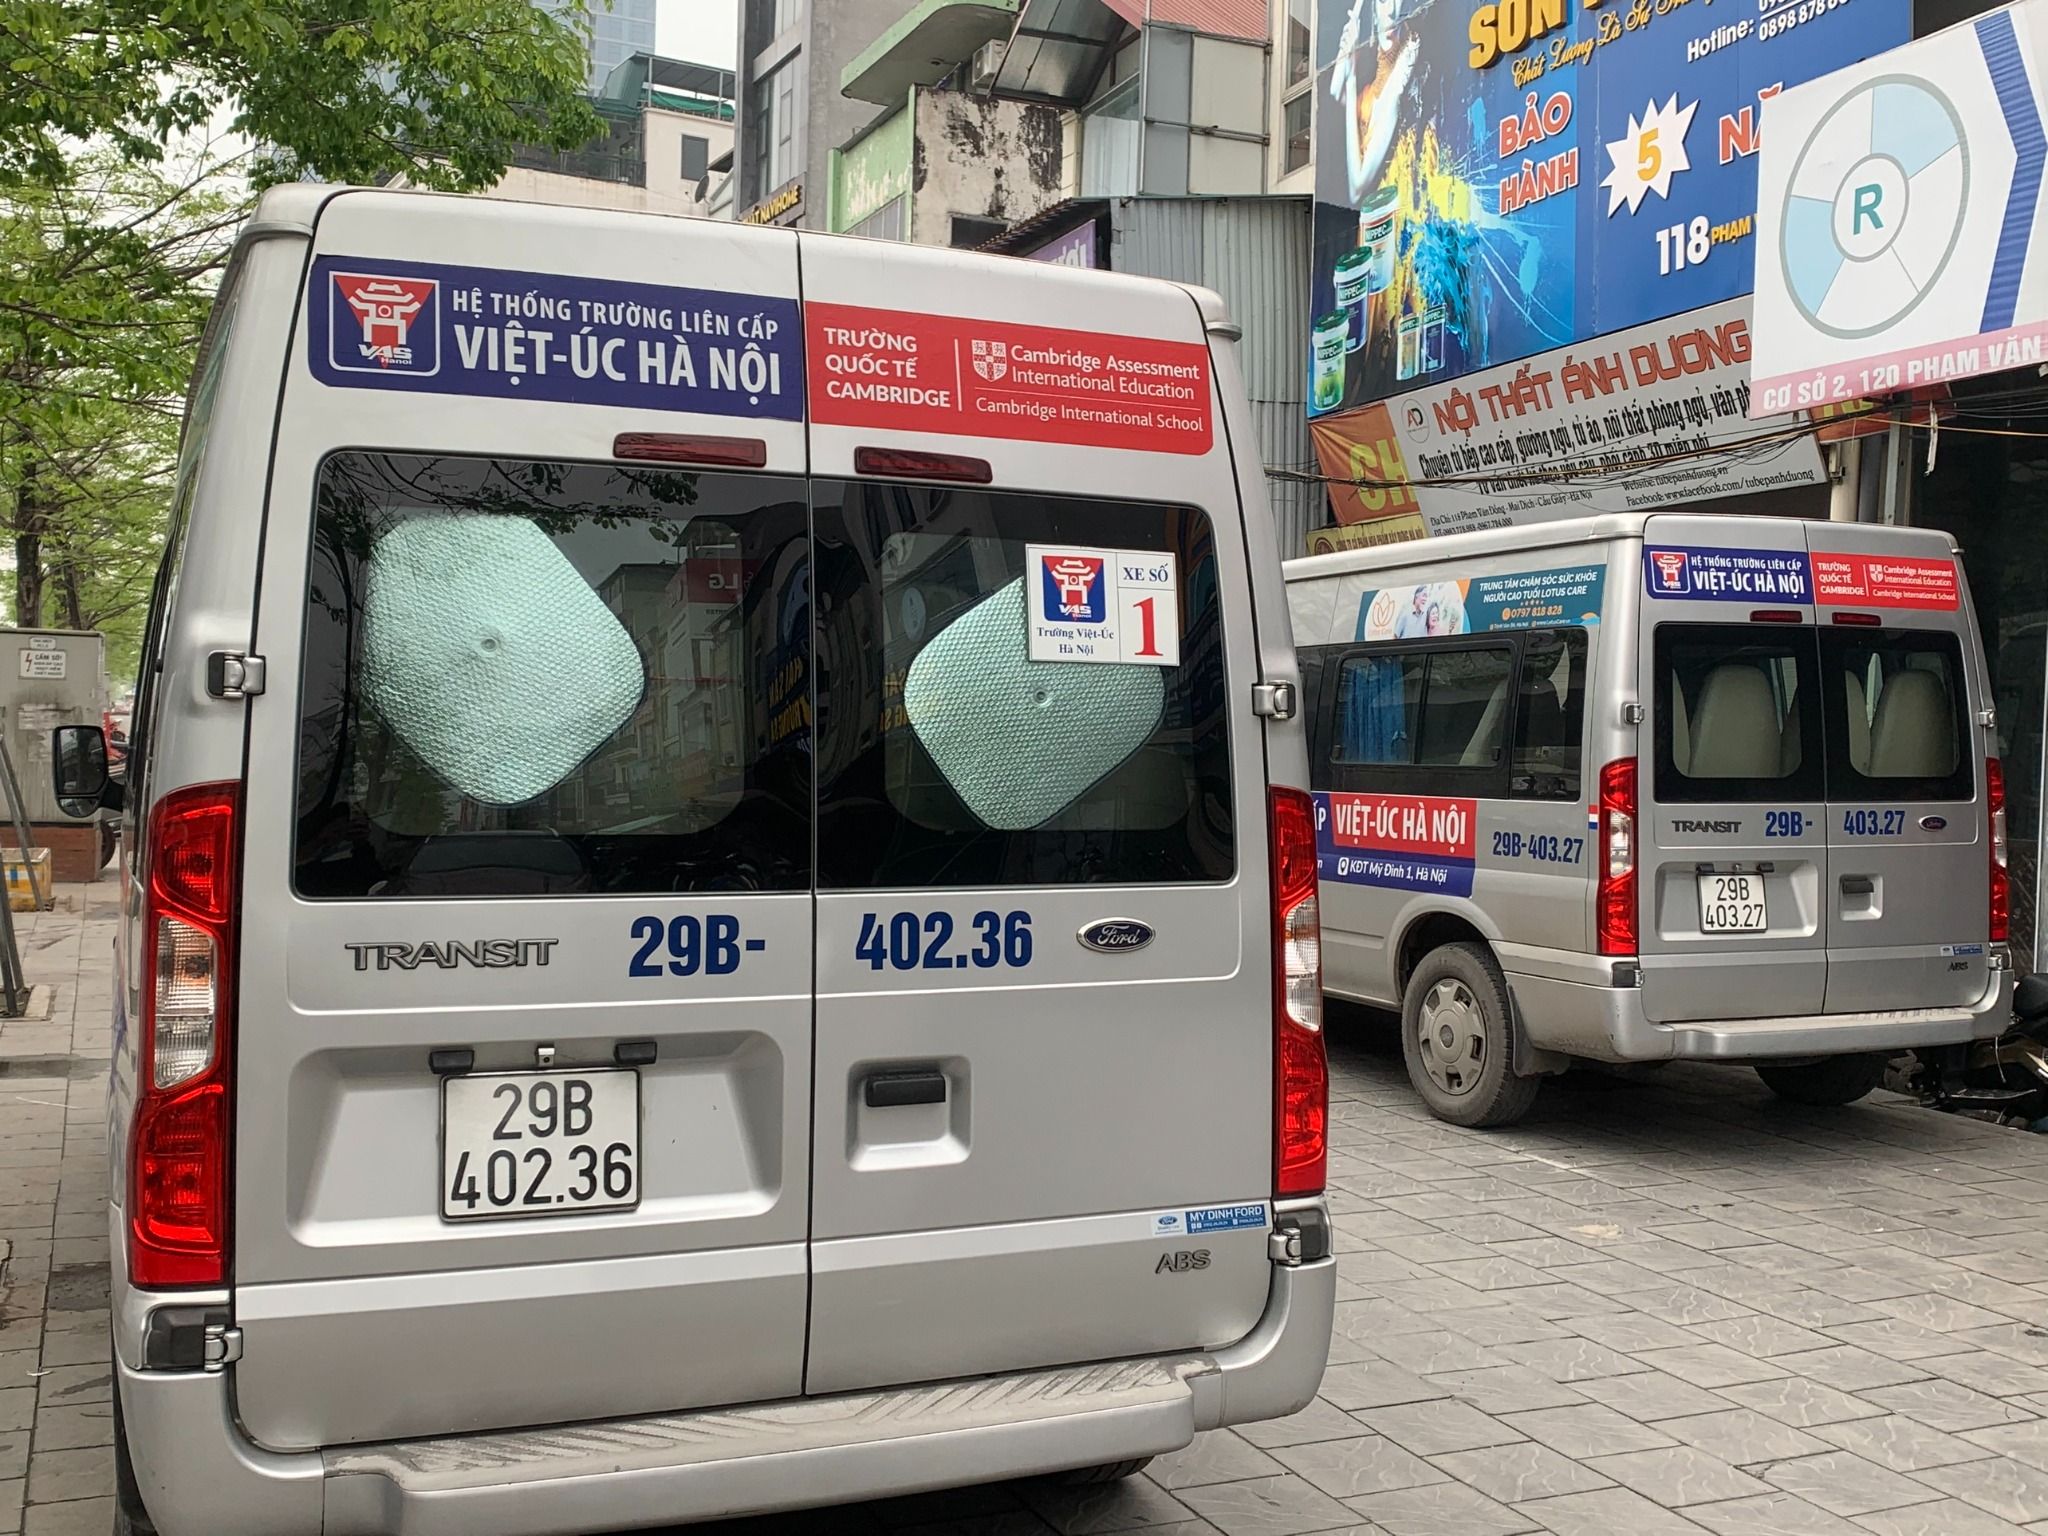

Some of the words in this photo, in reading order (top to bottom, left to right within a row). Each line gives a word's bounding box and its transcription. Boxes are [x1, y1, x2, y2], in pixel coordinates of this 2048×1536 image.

[1687, 19, 1754, 63] Hotline:
[1759, 10, 1797, 41] 0898
[1500, 91, 1573, 158] BẢO
[1637, 127, 1662, 181] 5
[1500, 147, 1579, 216] HÀNH
[1853, 183, 1884, 235] R
[1656, 216, 1710, 275] 118
[1711, 217, 1752, 245] PHẠM
[453, 287, 482, 314] HỆ
[490, 290, 571, 321] THỐNG
[578, 297, 673, 330] TRƯỜNG
[680, 306, 731, 336] LIÊN
[736, 312, 779, 340] CẤP
[358, 344, 412, 360] VAS
[824, 325, 917, 353] TRƯỜNG
[381, 357, 412, 365] Hanoi
[453, 318, 626, 386] VIỆT-ÚC
[638, 335, 697, 388] HÀ
[710, 341, 781, 405] NỘI
[825, 352, 890, 378] QUỐC
[892, 355, 918, 379] TẾ
[1011, 344, 1102, 371] Cambridge
[1106, 354, 1201, 380] Assessment
[1764, 383, 1792, 411] CƠ
[1798, 372, 1827, 402] SỞ
[1832, 375, 1853, 397] 2,
[1860, 364, 1900, 393] 120
[1987, 334, 2041, 369] VĂN
[1012, 366, 1115, 393] International
[1119, 376, 1195, 401] Education
[1432, 386, 1480, 438] NỘI
[1478, 363, 1554, 420] THẤT
[1561, 355, 1629, 404] ÁNH
[1629, 319, 1752, 387] DƯƠNG
[826, 380, 951, 408] CAMBRIDGE
[975, 397, 1057, 423] Cambridge
[1061, 405, 1154, 427] International
[1157, 414, 1204, 432] School
[1418, 449, 1454, 480] Chuyên
[1460, 437, 1480, 472] bếp
[1478, 442, 1498, 467] cao
[1602, 408, 1624, 445] nội
[1622, 398, 1649, 436] thất
[1646, 398, 1686, 437] phòng
[1710, 384, 1739, 417] văn
[1123, 567, 1145, 582] XE
[1148, 563, 1169, 582] SỐ
[1691, 555, 1702, 569] HỆ
[1703, 554, 1732, 568] THỐNG
[1733, 555, 1766, 570] TRƯỜNG
[1767, 559, 1785, 570] LIÊN
[1787, 558, 1802, 571] CẤP
[1817, 561, 1851, 573] TRƯỜNG
[1883, 565, 1917, 576] Cambridge
[1918, 567, 1953, 578] Assessment
[1480, 582, 1503, 592] TRUNG
[1542, 575, 1557, 587] SÓC
[1559, 573, 1574, 585] SỨC
[1693, 568, 1752, 596] VIỆT-ÚC
[1755, 570, 1776, 593] HÀ
[1779, 571, 1805, 599] NỘI
[1819, 573, 1844, 584] QUỐC
[1844, 573, 1852, 584] TẾ
[1820, 585, 1865, 596] CAMBRIDGE
[1884, 576, 1922, 585] International
[1923, 577, 1952, 587] Education
[1483, 590, 1507, 603] NGƯỜI
[1507, 591, 1522, 601] CAO
[1542, 586, 1566, 598] LOTUS
[1567, 585, 1588, 595] CARE
[1873, 589, 1902, 600] Cambridge
[1904, 590, 1937, 600] International
[1938, 593, 1956, 601] School
[1058, 603, 1092, 616] VAS
[1511, 608, 1530, 618] 0797
[1036, 626, 1074, 640] Trường
[1077, 626, 1114, 640] Việt-Úc
[1133, 597, 1164, 656] 1
[1059, 643, 1073, 654] Hà
[1076, 643, 1094, 655] Nội
[1336, 798, 1398, 844] VIỆT-ÚC
[1403, 802, 1428, 842] HÀ
[1432, 804, 1466, 854] NỘI
[1672, 819, 1741, 833] TRANSIT
[1765, 811, 1813, 837] 29B-
[1843, 810, 1906, 835] 403.27
[1492, 831, 1584, 864] 29B-403.27
[1349, 860, 1369, 874] KĐT
[1369, 863, 1383, 878] Mỹ
[1416, 866, 1429, 881] Hà
[1430, 868, 1448, 885] Nội
[1715, 878, 1750, 901] 29B
[1705, 904, 1764, 928] 403.27
[628, 914, 766, 978] 29B-
[855, 910, 1033, 971] 402.36
[1097, 923, 1140, 946] Ford
[344, 937, 559, 971] TRANSIT
[493, 1079, 593, 1140] 29B
[451, 1142, 632, 1209] 402.36
[1190, 1212, 1206, 1222] MY
[1207, 1209, 1234, 1220] DINH
[1234, 1206, 1263, 1218] FORD
[1155, 1249, 1212, 1274] ABS
